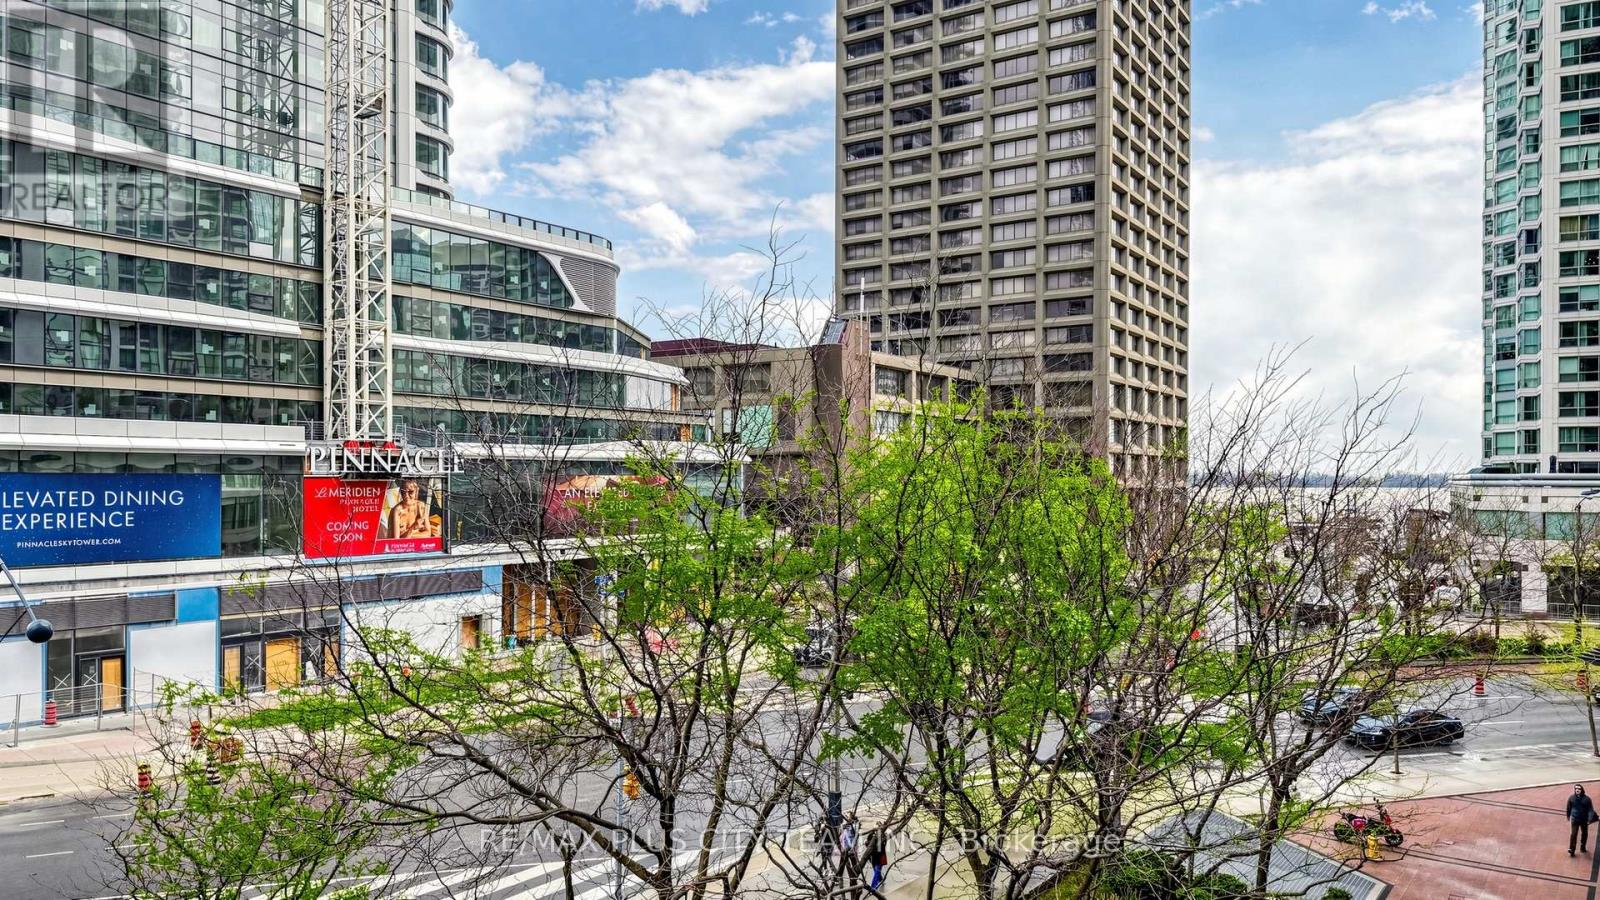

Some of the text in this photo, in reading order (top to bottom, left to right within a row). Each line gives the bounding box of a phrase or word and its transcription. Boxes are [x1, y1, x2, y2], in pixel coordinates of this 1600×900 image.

[306, 447, 465, 474] PINNACLE
[328, 487, 381, 498] MERIDIEN
[565, 487, 581, 499] AN
[584, 486, 630, 499] ELETED
[2, 490, 185, 508] LEVATED DINING
[353, 505, 380, 513] HOTEL
[2, 511, 135, 531] EXPERIENCE
[17, 538, 122, 548] PINNACLESKYTOWER.COM
[333, 533, 363, 543] SOON
